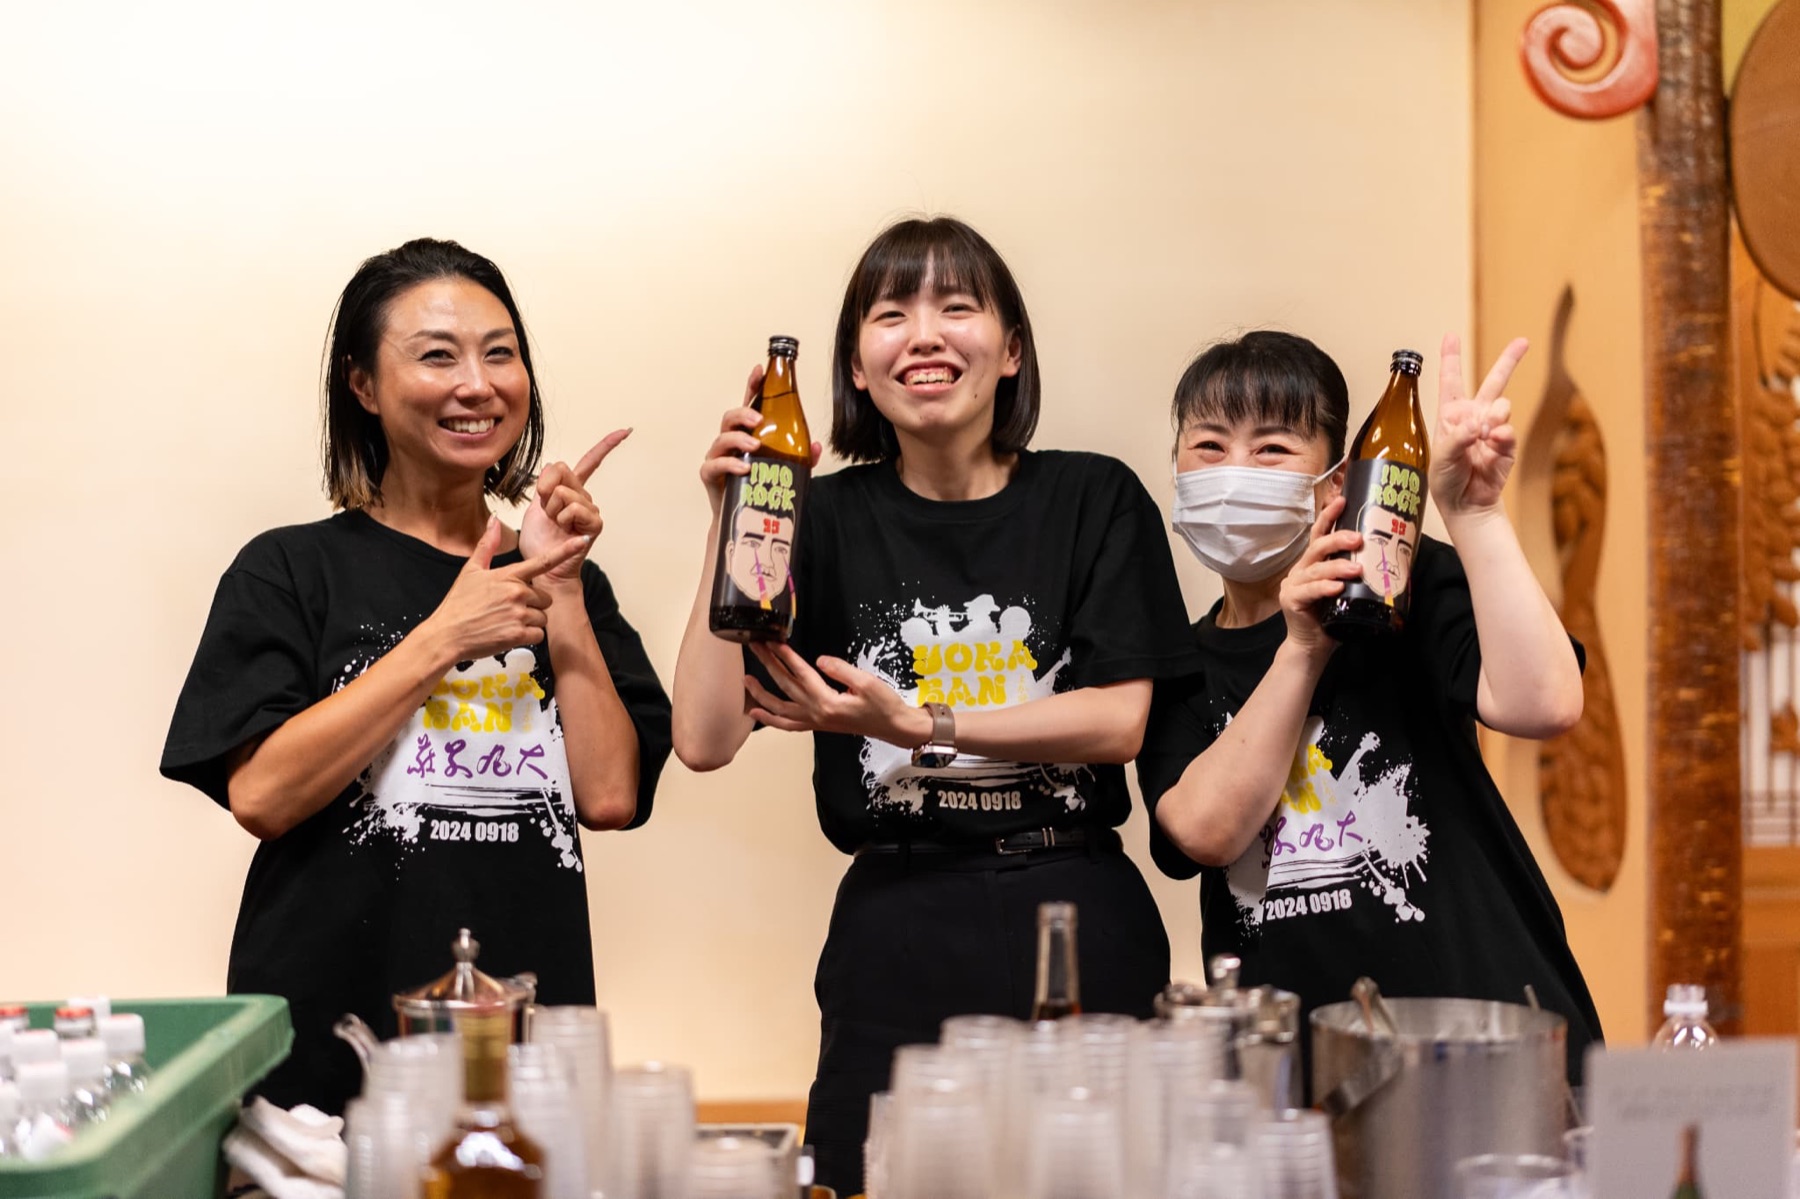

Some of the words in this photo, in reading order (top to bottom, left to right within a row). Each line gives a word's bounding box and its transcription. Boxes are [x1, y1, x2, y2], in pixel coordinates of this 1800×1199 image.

[750, 462, 793, 488] IMO
[1380, 464, 1420, 494] IMO
[741, 482, 796, 510] ROCK
[1371, 482, 1421, 515] ROCK
[423, 700, 513, 733] BAN
[937, 790, 978, 810] 2024
[980, 790, 1022, 811] 0918
[429, 821, 472, 842] 2024
[474, 821, 520, 843] 0918
[1265, 895, 1308, 921] 2024
[1309, 889, 1353, 915] 0918
